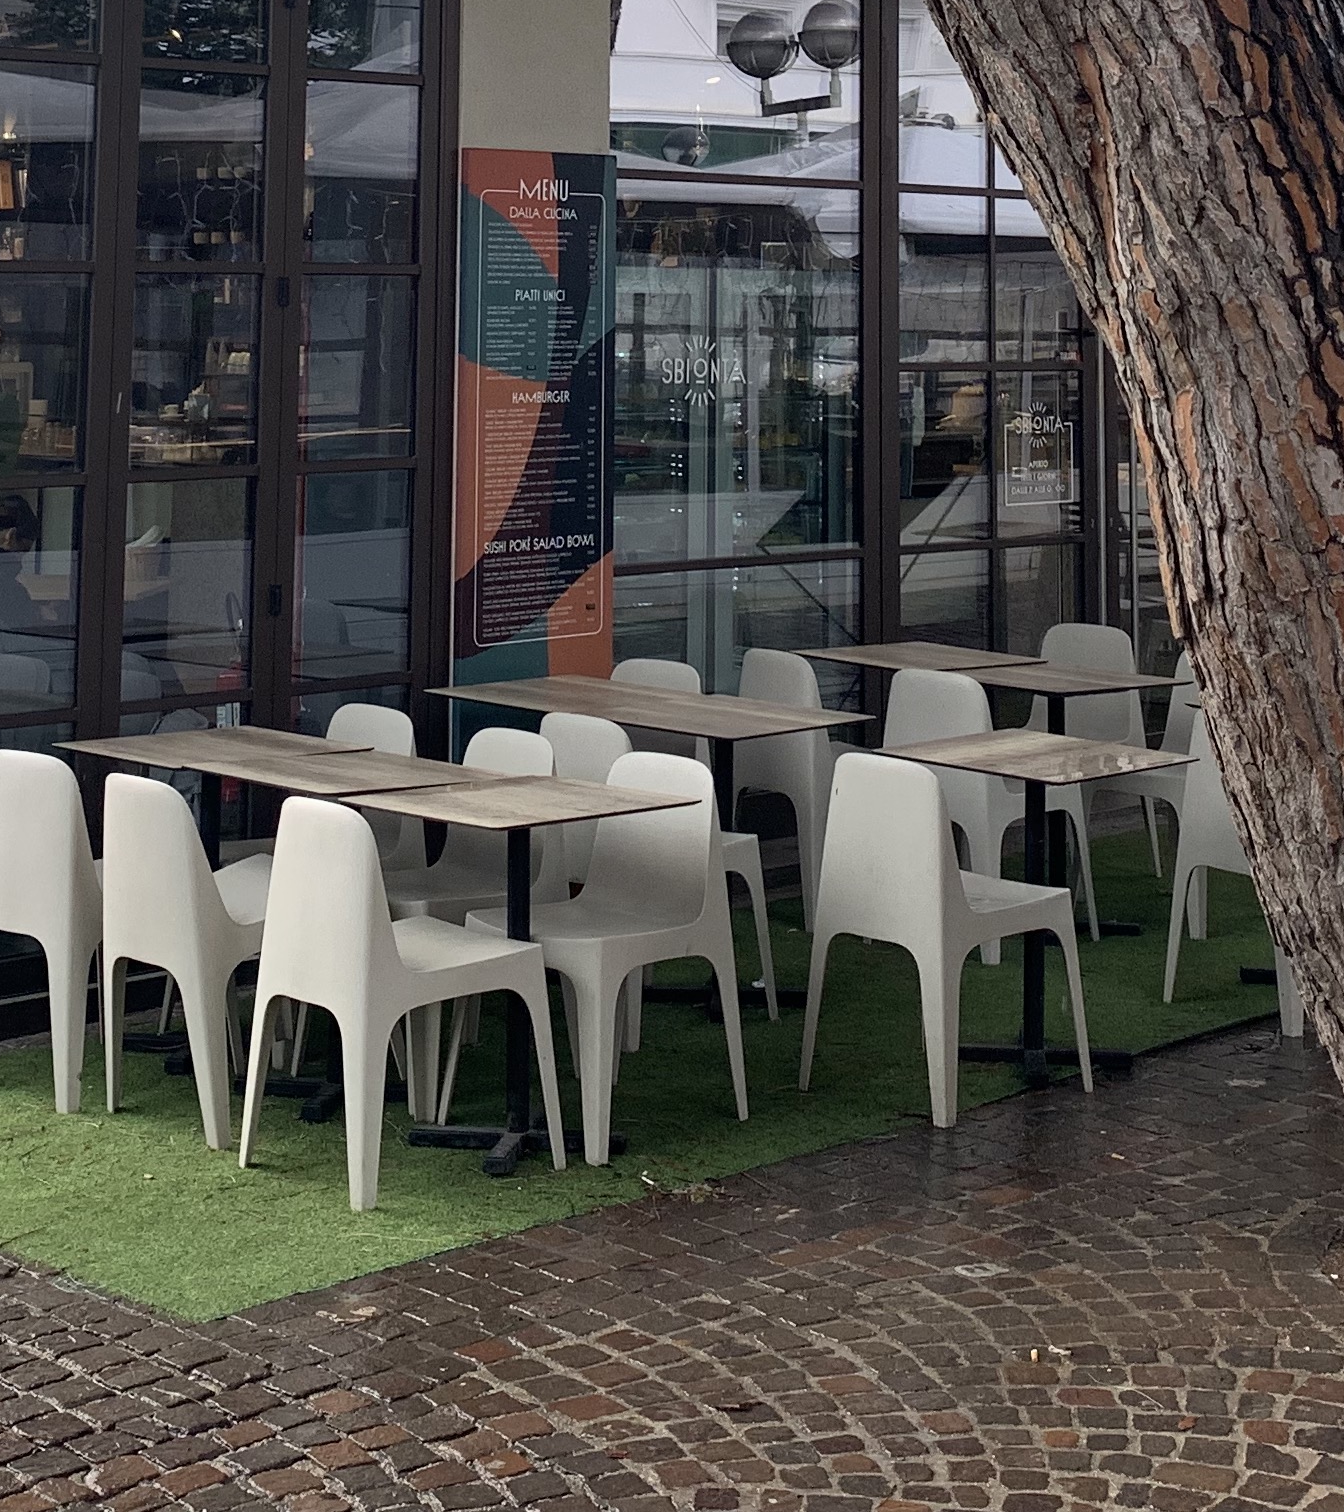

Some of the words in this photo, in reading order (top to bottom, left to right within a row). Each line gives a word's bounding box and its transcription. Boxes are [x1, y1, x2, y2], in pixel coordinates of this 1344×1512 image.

[519, 178, 569, 202] MENU
[509, 206, 541, 220] DALLA
[543, 207, 578, 221] CUCINA
[515, 289, 540, 302] PIATTI
[542, 290, 566, 302] UNICI
[661, 357, 746, 384] SBIONTA
[512, 390, 571, 404] HAMBURGER
[1015, 416, 1065, 435] SBIONTA
[483, 541, 507, 555] SUSHI
[533, 536, 565, 550] SALAD
[567, 533, 595, 548] BOWL
